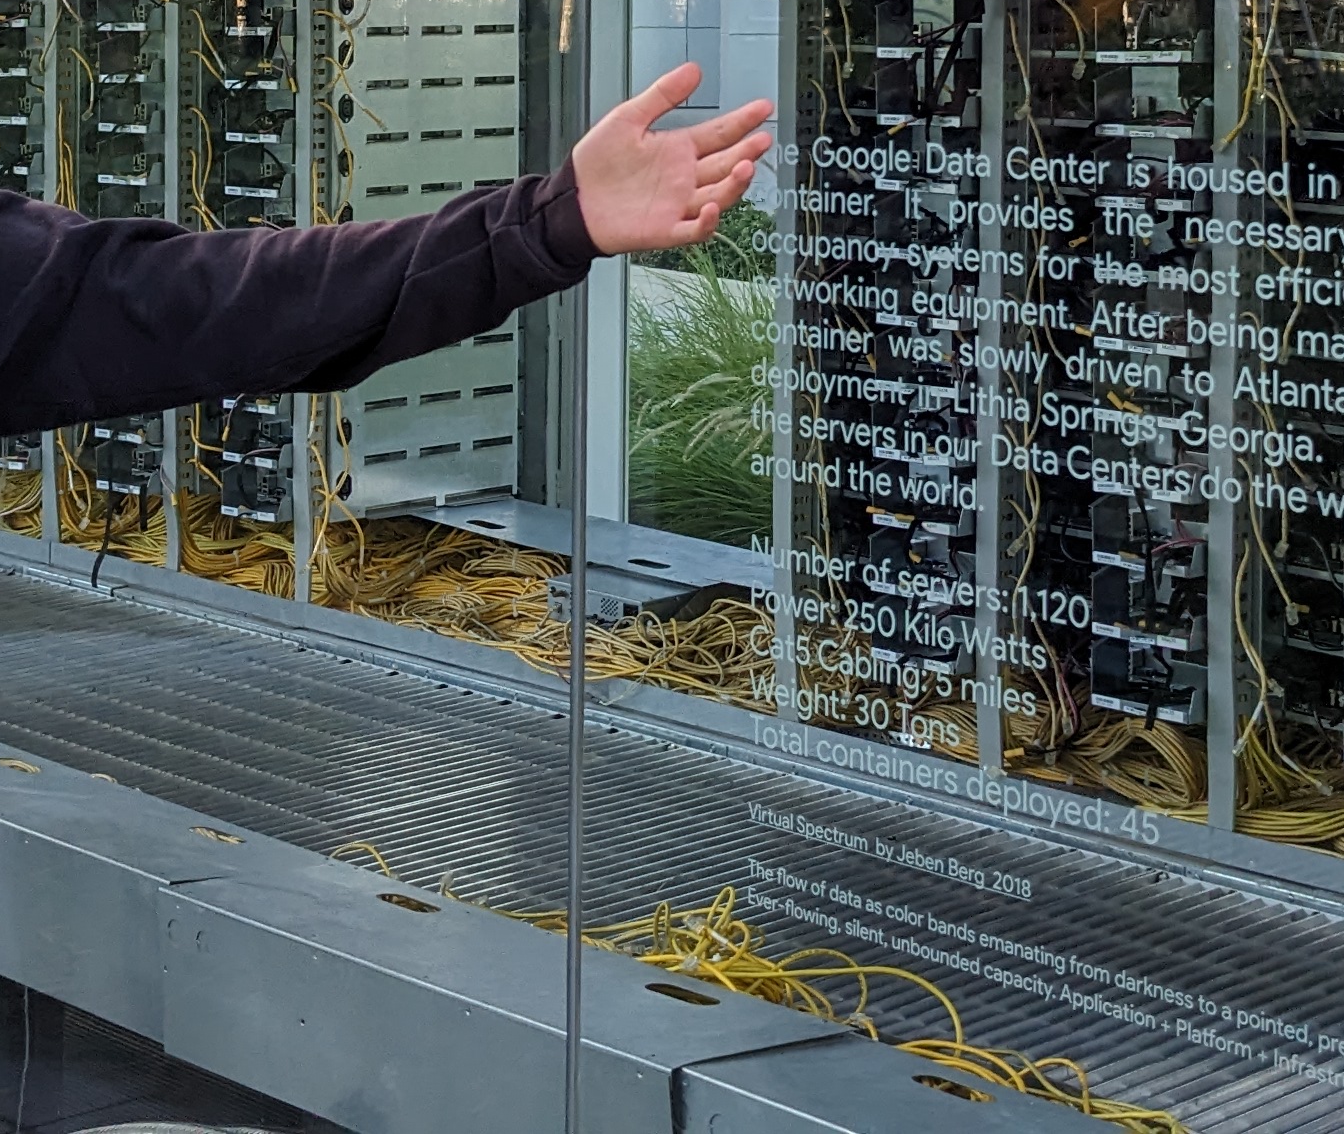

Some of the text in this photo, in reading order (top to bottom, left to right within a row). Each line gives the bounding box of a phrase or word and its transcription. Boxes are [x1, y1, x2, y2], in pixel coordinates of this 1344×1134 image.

[812, 136, 912, 179] Google
[926, 142, 991, 177] Data
[1006, 146, 1110, 185] Center
[1126, 153, 1150, 187] is
[1168, 155, 1290, 197] housed
[1308, 163, 1337, 200] in
[905, 187, 922, 220] It
[949, 195, 1074, 232] provides
[1102, 204, 1154, 238] the
[752, 229, 896, 272] occupancy
[907, 235, 1024, 277] systems
[1036, 245, 1080, 280] for
[1093, 251, 1143, 288] the
[1158, 265, 1241, 297] most
[751, 318, 875, 354] container
[888, 334, 942, 363] was
[959, 336, 1049, 384] slowly
[1066, 347, 1161, 390] driven
[1181, 362, 1215, 397] to
[753, 272, 898, 316] networking
[912, 286, 1075, 330] equipment.
[1090, 300, 1170, 339] After
[1187, 309, 1279, 362] being
[751, 357, 906, 406] deployment
[918, 376, 942, 408] in
[954, 380, 1030, 422] Lithia
[1042, 391, 1165, 447] Springs,
[1178, 411, 1323, 467] Georgia.
[751, 398, 792, 434] the
[799, 415, 896, 449] servers
[904, 421, 926, 454] in
[935, 435, 983, 463] our
[991, 433, 1058, 475] Data
[1066, 445, 1191, 496] Centers
[1200, 467, 1242, 503] do
[1252, 473, 1307, 513] the
[750, 453, 985, 512] around the world.
[751, 534, 1090, 629] Number of servers: 1,120
[751, 580, 1047, 670] Power: 250 Kilo Watts
[748, 668, 960, 746] Weight: 30 Tons
[749, 625, 1036, 716] Cat5 Cabling: 5 miles
[750, 713, 1160, 845] Total containers deployed: 45
[748, 802, 1032, 898] Virtual Spectrum by Jeben Berg 2018
[747, 886, 841, 935] Ever-flowing,
[844, 918, 888, 948] silent,
[891, 935, 981, 975] unbounded
[984, 964, 1056, 1002] capacity.
[1059, 983, 1156, 1029] Application
[1160, 1019, 1171, 1032] +
[1176, 1018, 1252, 1060] Platform
[1257, 1050, 1268, 1063] +
[748, 858, 774, 881] The
[776, 867, 808, 892] flow
[810, 880, 827, 898] of
[829, 885, 862, 909] data
[865, 898, 883, 915] as
[885, 904, 925, 928] color
[927, 912, 976, 943] bands
[979, 932, 1065, 975] emanating
[1069, 955, 1110, 984] from
[1114, 969, 1194, 1009] darkness
[1197, 994, 1217, 1015] to
[1221, 1005, 1232, 1020] a
[1236, 1009, 1314, 1047] pointed,
